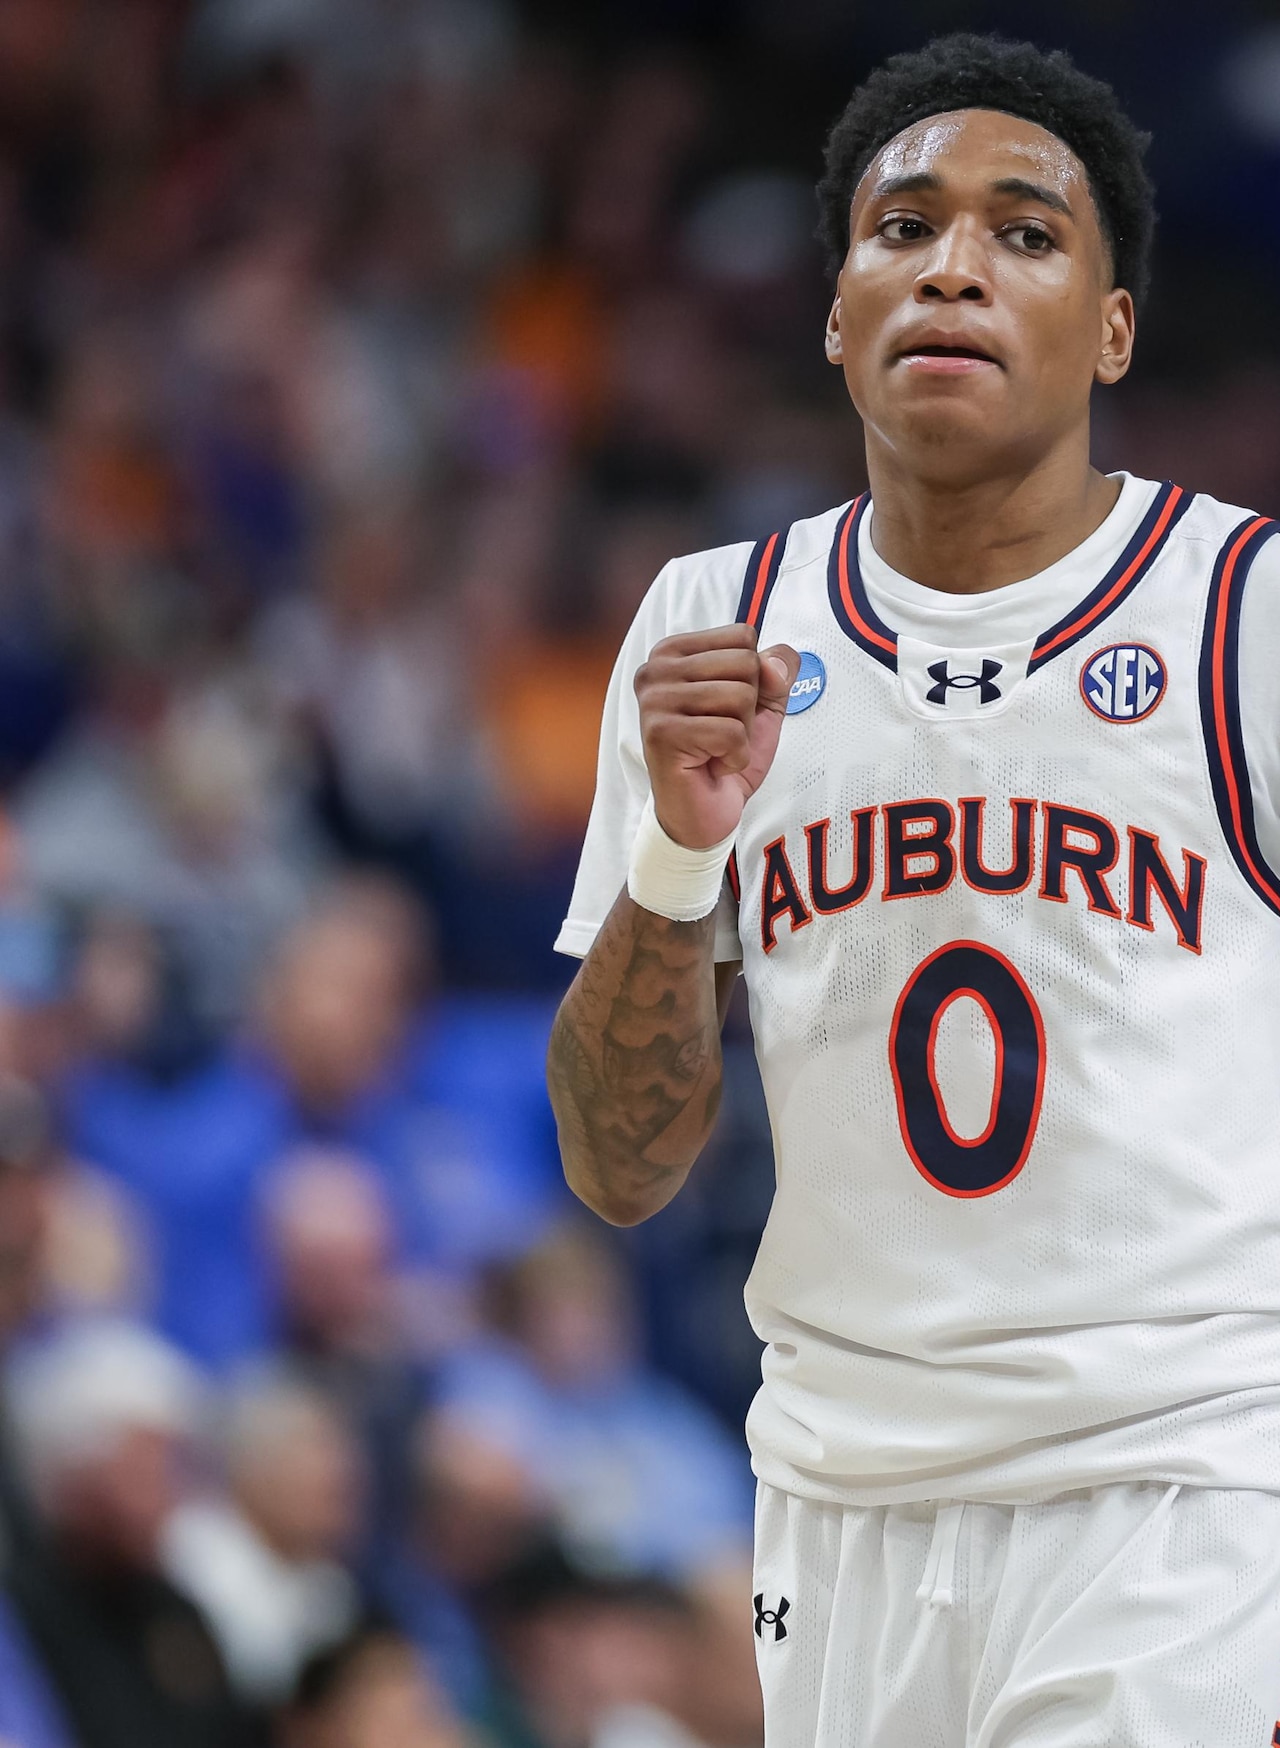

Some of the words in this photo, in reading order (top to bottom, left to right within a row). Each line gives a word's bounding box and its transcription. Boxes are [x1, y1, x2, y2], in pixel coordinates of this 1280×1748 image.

[789, 676, 821, 697] CAA
[1088, 649, 1160, 717] SEC
[761, 796, 1208, 956] AUBURN
[888, 939, 1047, 1199] 0
